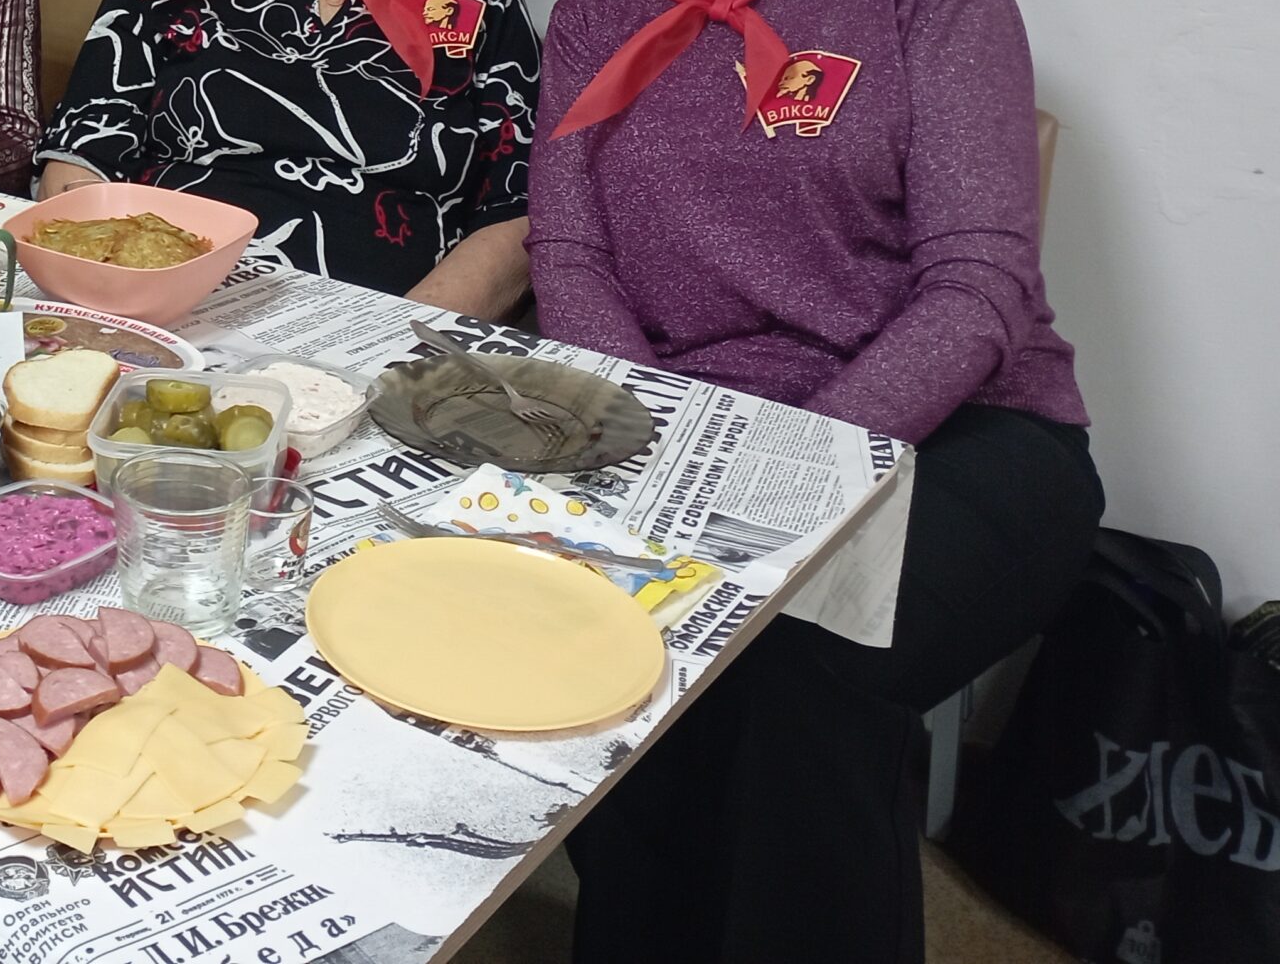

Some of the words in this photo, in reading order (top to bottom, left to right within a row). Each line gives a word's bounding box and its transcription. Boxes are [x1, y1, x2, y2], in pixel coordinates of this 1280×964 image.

[429, 31, 470, 44] ЛКСМ
[766, 104, 830, 123] ВЛКСМ
[35, 303, 126, 327] КУПЕЧЕСКИЙ
[127, 322, 179, 347] ШЕДЕВР
[720, 413, 750, 454] НАРОДУ
[667, 457, 704, 506] ОБРАЩЕНИЕ
[692, 409, 726, 458] ПРЕЗИДЕНТА
[681, 454, 730, 529] СОВЕТСКОМУ
[674, 530, 693, 542] К
[671, 581, 745, 652] ОМОЛЬСКАЯ
[109, 836, 256, 909] ИСТИН
[3, 898, 53, 929] Орган
[155, 909, 175, 926] 21
[172, 926, 220, 958] И.
[213, 884, 335, 941] Брежн
[11, 911, 86, 964] Комитета
[29, 923, 89, 964] ВЛКСМ
